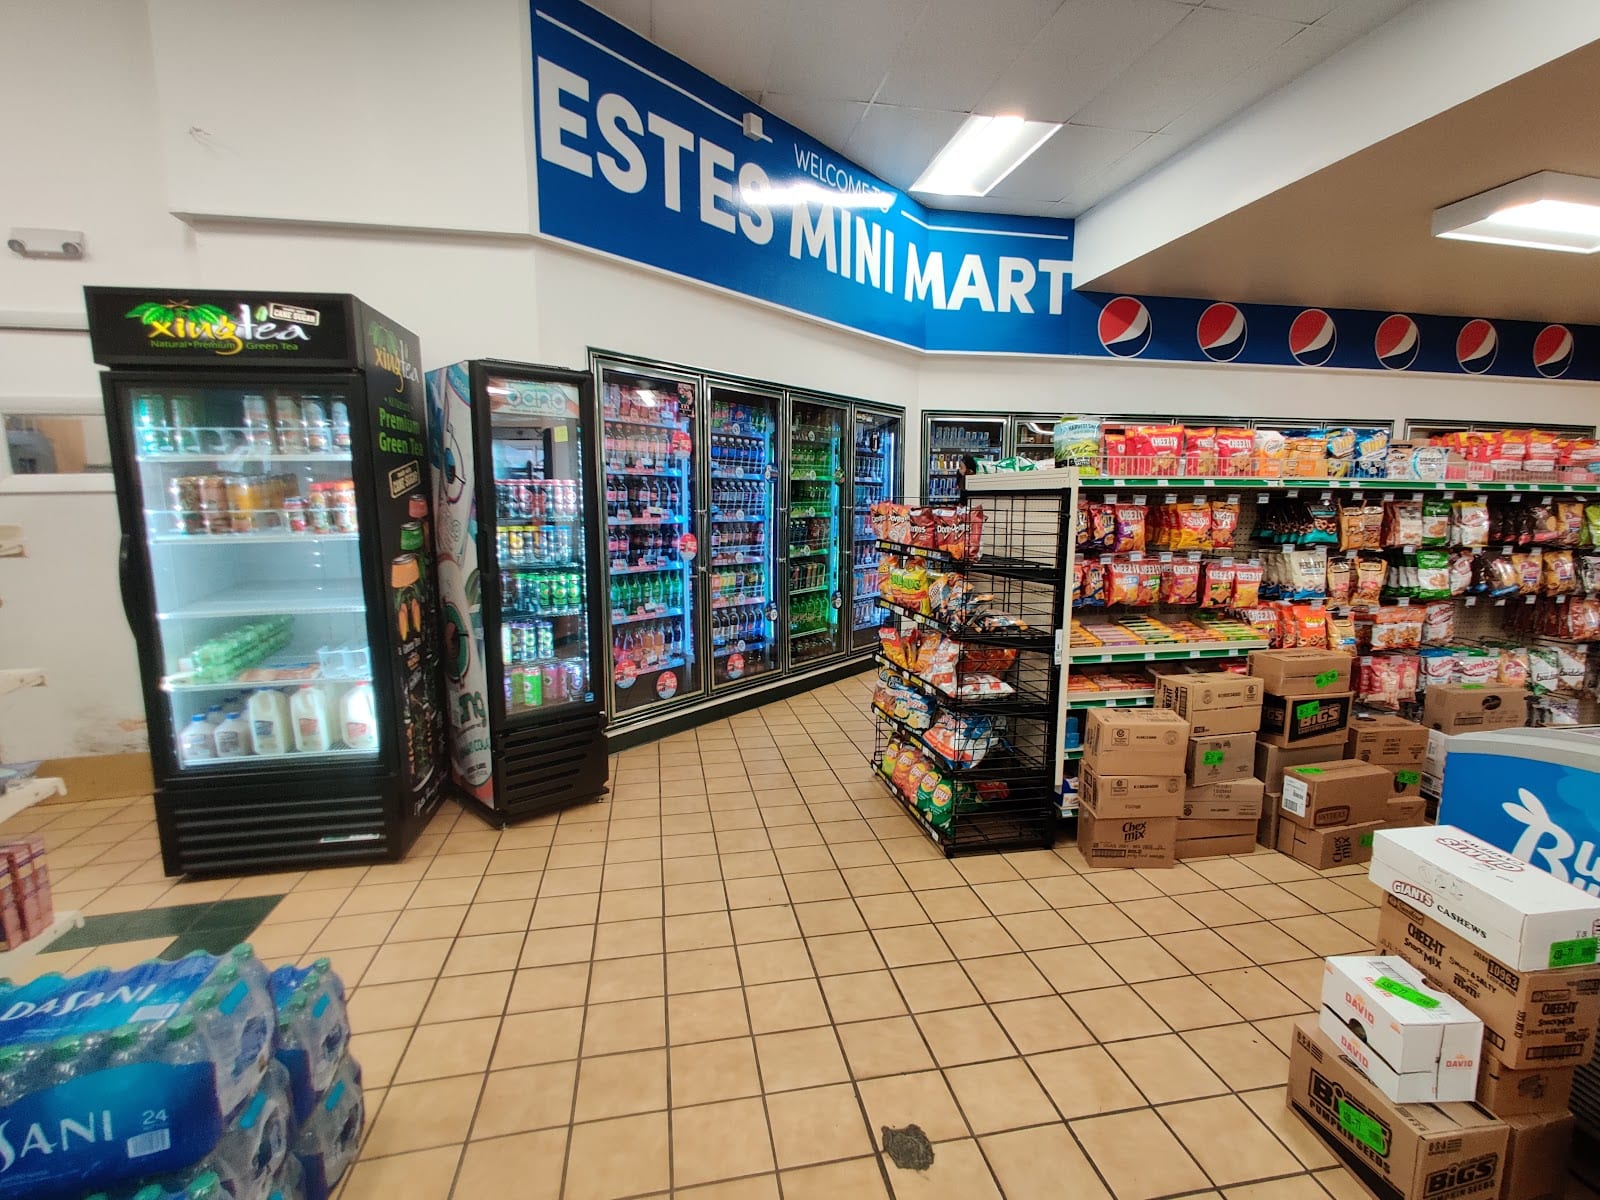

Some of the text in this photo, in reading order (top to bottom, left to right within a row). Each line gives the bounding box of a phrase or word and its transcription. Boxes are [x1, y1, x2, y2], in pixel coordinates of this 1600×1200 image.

[537, 56, 1073, 315] ESTES MINI MART
[793, 143, 870, 196] WELCOME
[246, 341, 280, 351] Green
[281, 341, 299, 351] Tea
[379, 406, 421, 436] Premium
[379, 431, 408, 453] Green
[1122, 821, 1147, 833] Chex
[1124, 830, 1145, 841] mix
[1392, 881, 1488, 939] GIANTS CASHEWS
[1407, 922, 1447, 957] CHEEZ-IT
[0, 984, 157, 1022] DASANI
[1345, 991, 1375, 1025] DAVID
[1341, 1035, 1369, 1070] DAVID
[1445, 1060, 1473, 1068] DAVID
[141, 1108, 170, 1127] 24
[1309, 1099, 1392, 1175] PUMPKIN SEEDS
[1467, 1179, 1496, 1195] SEEDS
